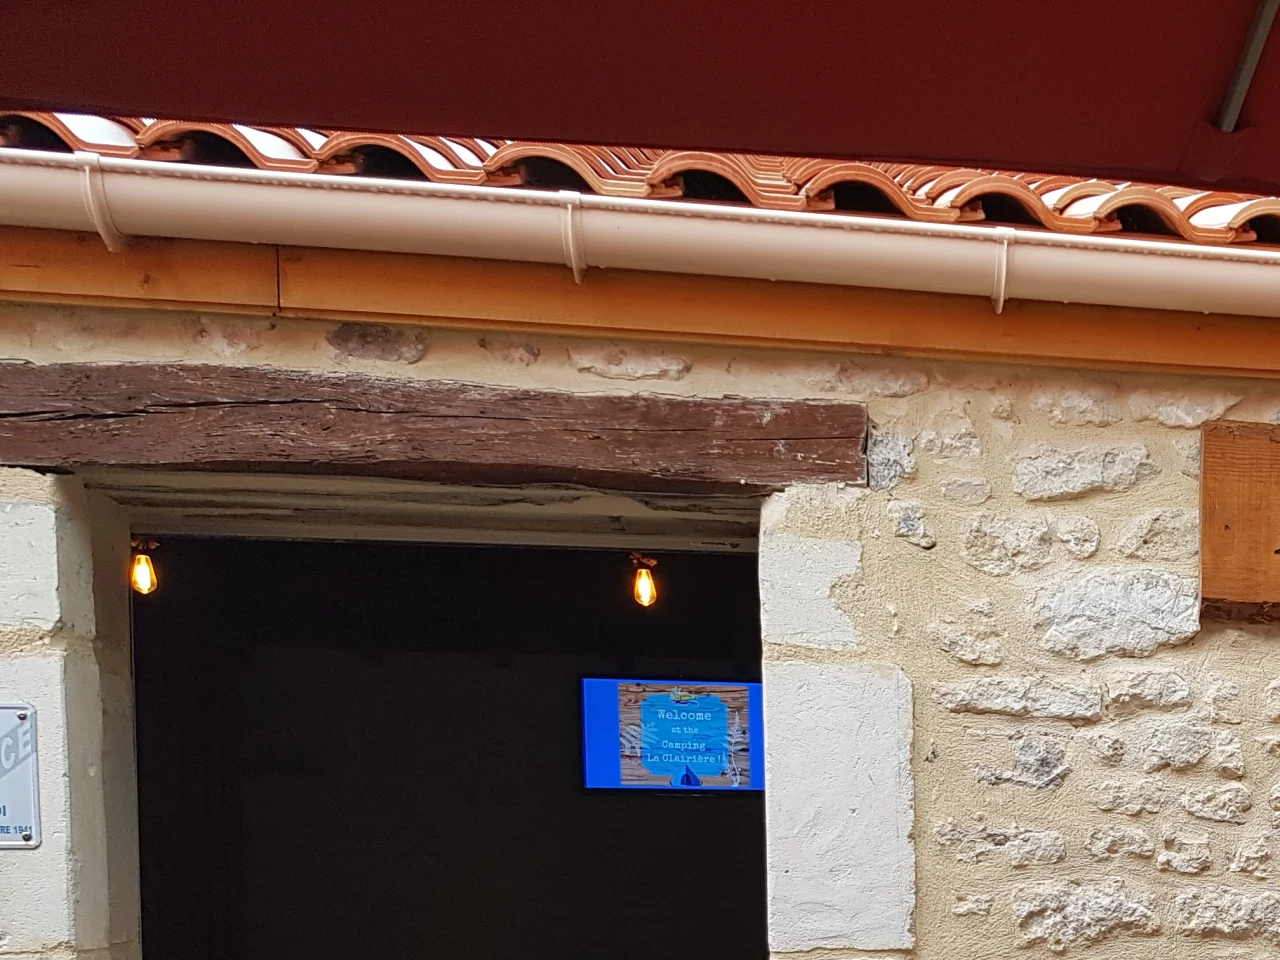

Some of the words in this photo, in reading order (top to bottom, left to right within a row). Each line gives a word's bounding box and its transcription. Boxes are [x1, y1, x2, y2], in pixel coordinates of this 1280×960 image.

[656, 709, 712, 721] Welcome
[671, 726, 682, 734] at
[684, 726, 699, 734] the
[0, 723, 32, 769] CE
[661, 740, 706, 751] Camping
[647, 753, 659, 762] La
[662, 753, 716, 763] Clairière
[0, 825, 11, 835] RE
[13, 825, 33, 835] 1941
